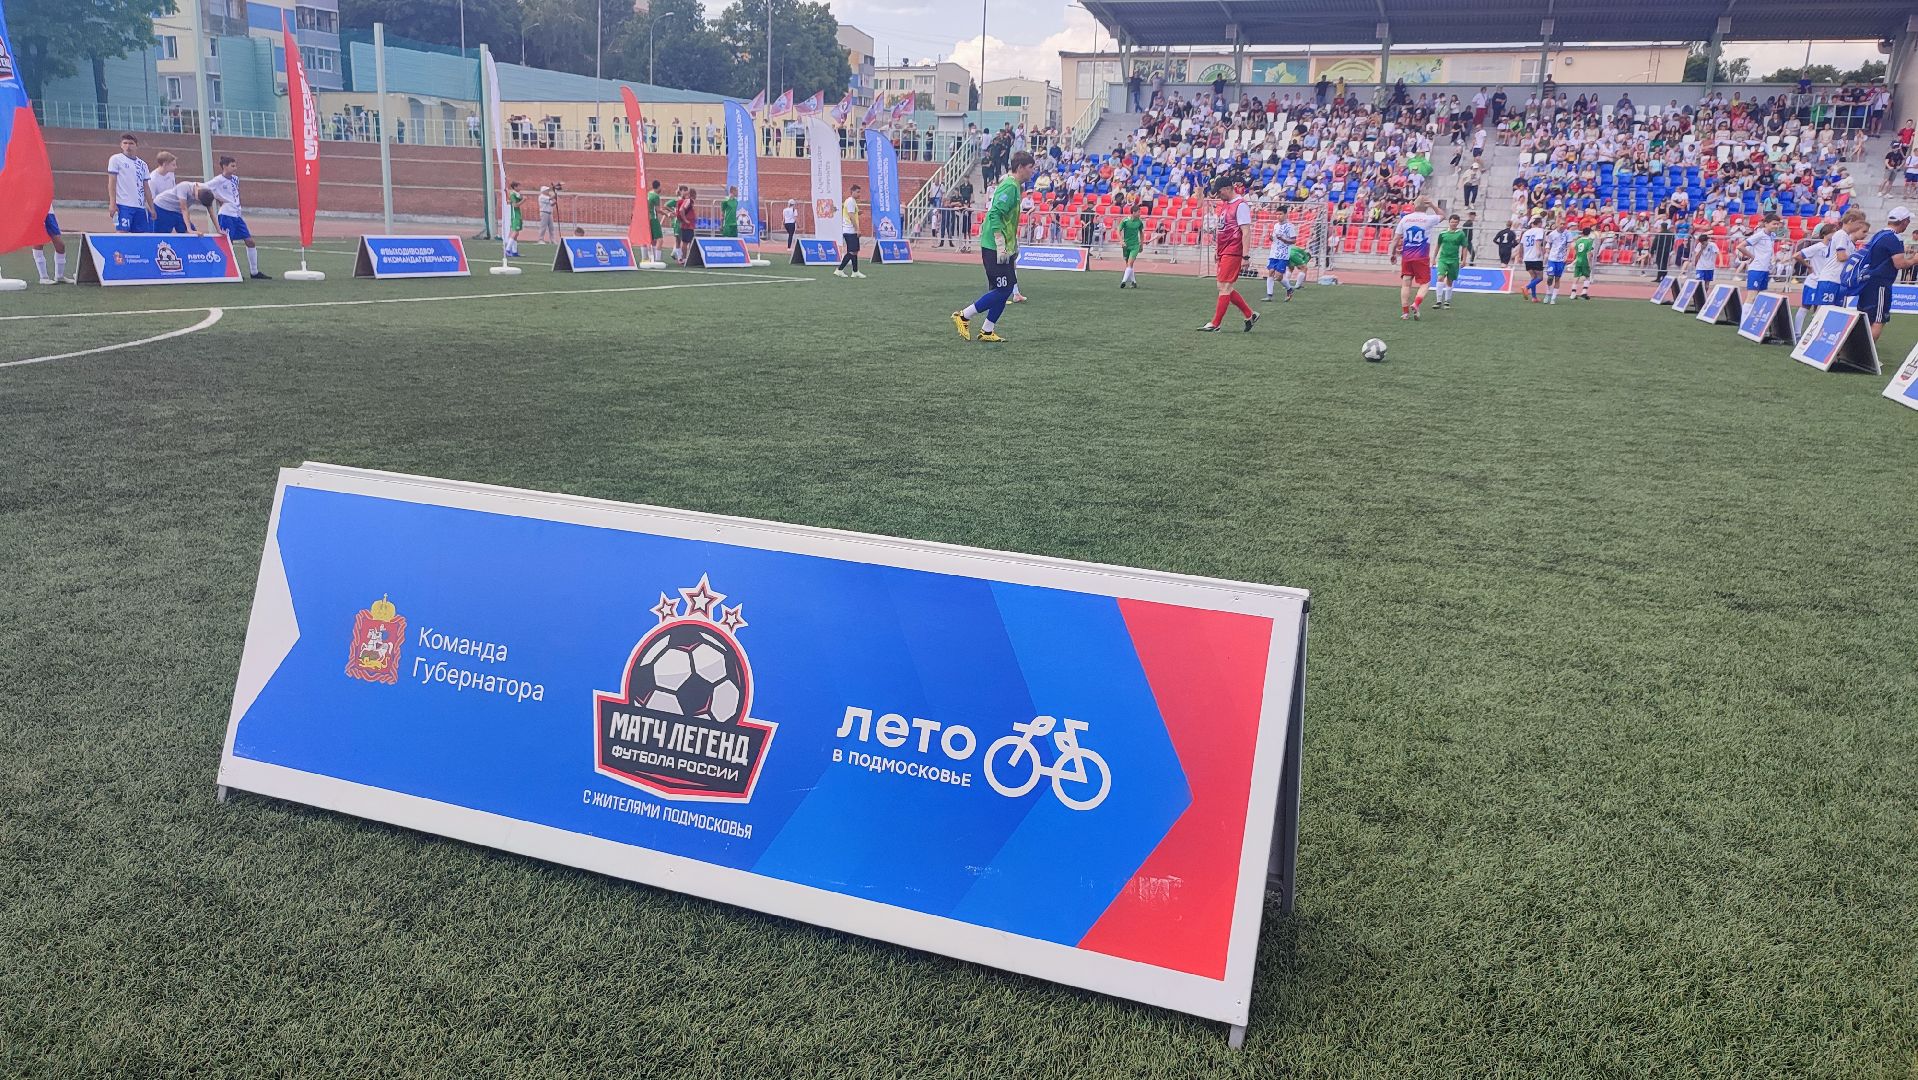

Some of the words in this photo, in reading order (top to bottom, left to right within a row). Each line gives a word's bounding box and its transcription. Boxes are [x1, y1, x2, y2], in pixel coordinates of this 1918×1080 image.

[121, 217, 130, 227] 21
[1407, 230, 1423, 243] 14
[1502, 233, 1508, 243] 1
[996, 276, 1007, 288] 36
[1822, 292, 1835, 303] 29
[418, 626, 508, 664] Команда
[412, 656, 545, 703] Губернатора
[609, 711, 667, 749] МАТЧ
[667, 722, 750, 766] ЛЕГЕНД
[836, 705, 977, 760] лето
[611, 745, 675, 769] ФУТБОЛА
[677, 758, 739, 782] РОССИИ
[583, 789, 592, 804] С
[592, 792, 661, 820] ЖИТЕЛЯМИ
[663, 807, 753, 840] ПОДМОСКОВЬЯ
